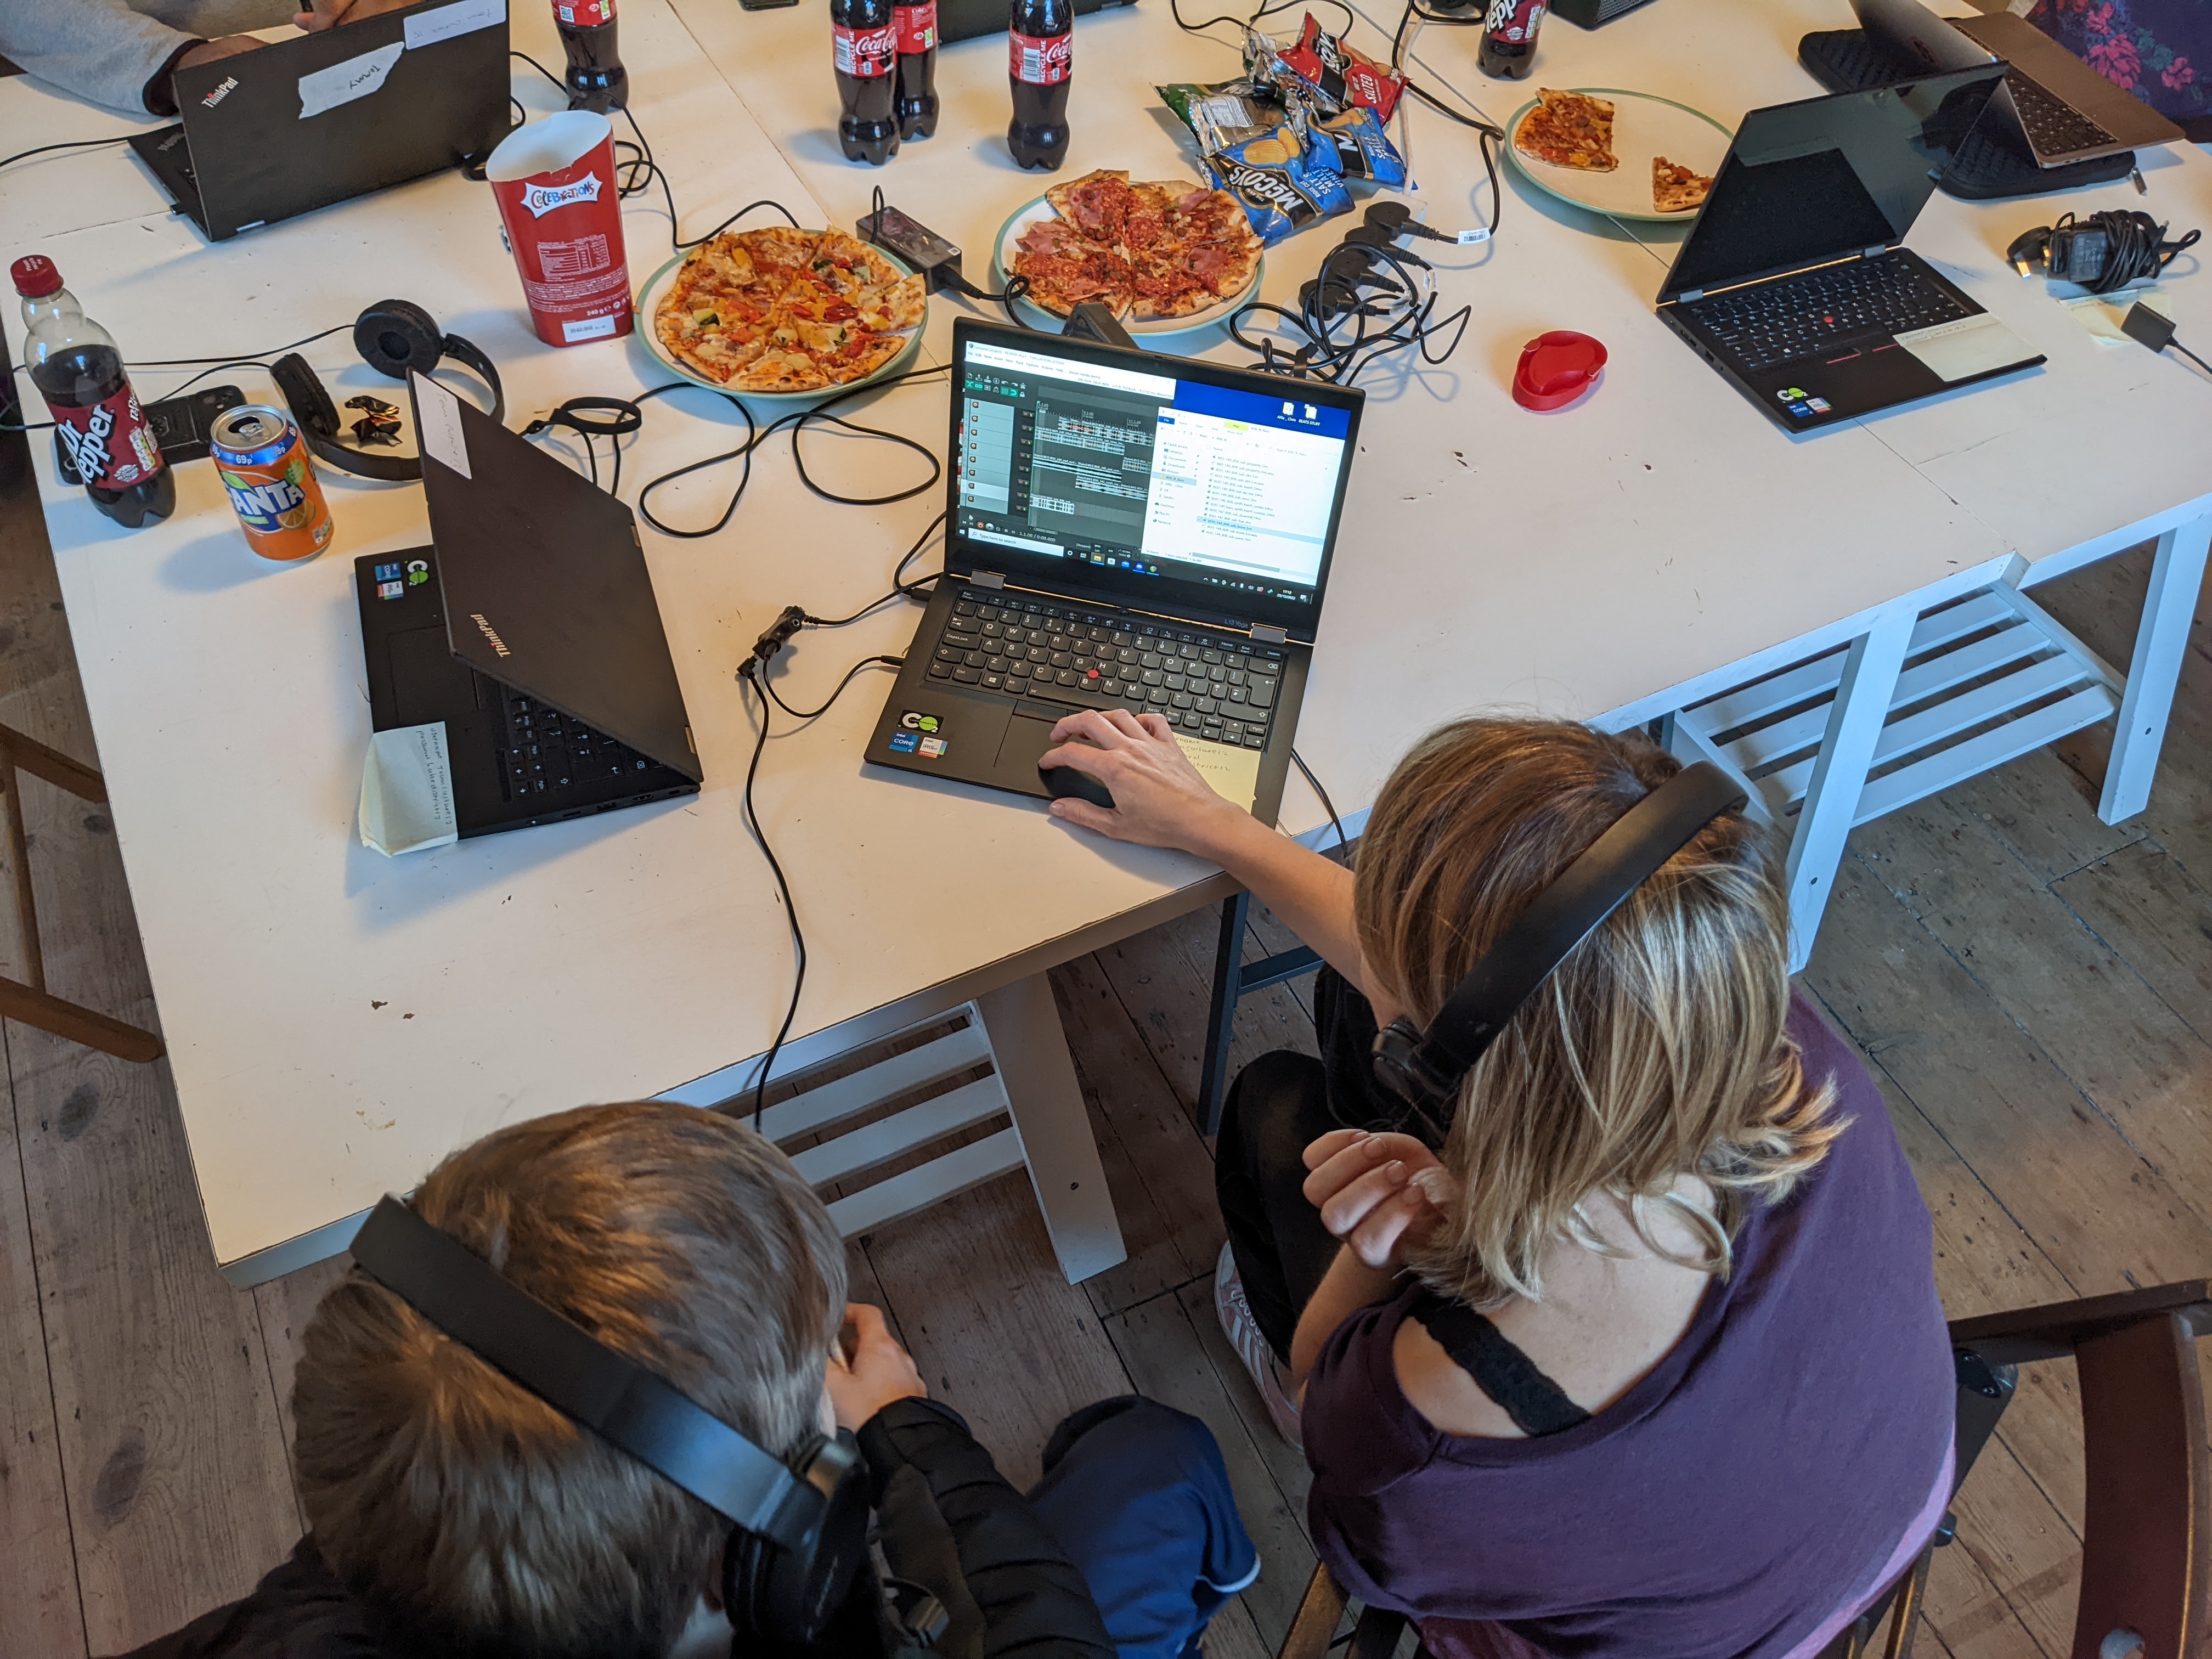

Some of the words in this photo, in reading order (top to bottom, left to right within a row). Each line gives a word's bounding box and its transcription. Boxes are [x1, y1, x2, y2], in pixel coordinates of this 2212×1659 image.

[849, 30, 855, 42] ME
[1040, 40, 1046, 50] ME
[201, 76, 239, 108] ThinkPad
[1360, 74, 1376, 104] SALTED
[1310, 178, 1331, 195] SALT
[1313, 171, 1335, 187] MALT
[1235, 620, 1248, 629] Yoga
[470, 613, 511, 658] ThinkPad
